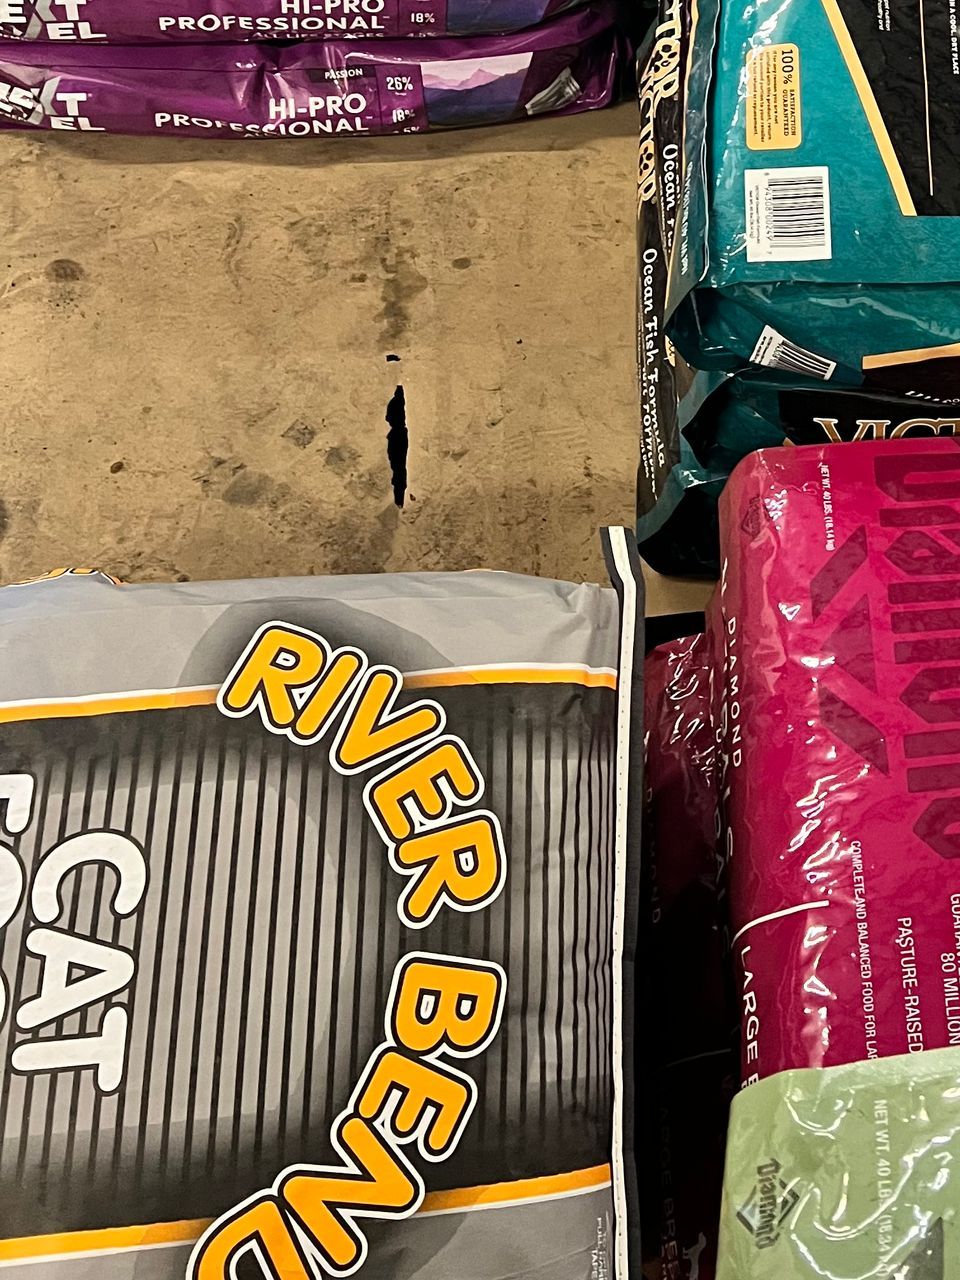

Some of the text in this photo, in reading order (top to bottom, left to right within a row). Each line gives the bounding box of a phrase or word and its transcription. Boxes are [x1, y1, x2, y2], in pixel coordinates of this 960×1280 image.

[159, 14, 385, 32] PROFESSIONAL
[411, 13, 435, 23] 18%
[325, 69, 363, 80] PASSION
[386, 77, 413, 91] 26%
[782, 48, 794, 85] 100%
[269, 94, 367, 120] HI-PRO
[392, 109, 415, 123] 18%
[789, 88, 797, 136] SATISFACTION
[662, 144, 679, 211] Ocean
[642, 248, 660, 366] Ocean Fish
[725, 616, 743, 768] DIAMOND
[217, 620, 508, 929] RIVER
[850, 840, 866, 894] COMPLETE
[854, 896, 867, 919] AND
[11, 827, 150, 1096] CAT
[857, 922, 872, 979] BALANCED
[940, 953, 956, 973] 80
[740, 945, 760, 1065] LARGE
[861, 981, 875, 1012] FOOD
[897, 917, 925, 1054] PASTURE-RAISED
[864, 1014, 877, 1038] FOR
[873, 1099, 891, 1177] NET WT. 40
